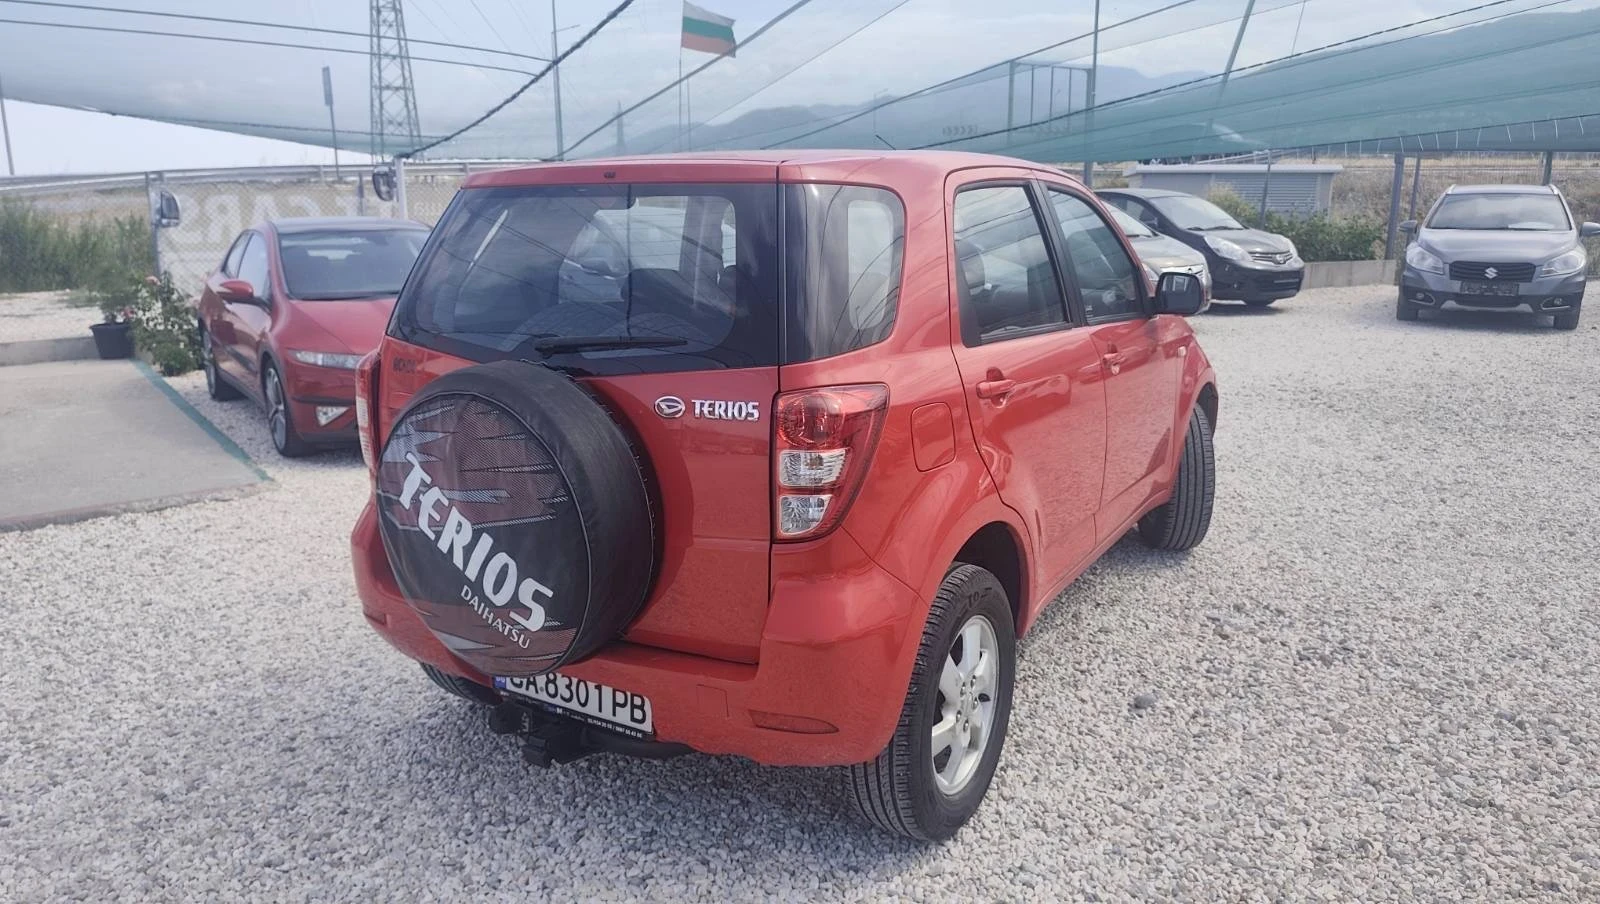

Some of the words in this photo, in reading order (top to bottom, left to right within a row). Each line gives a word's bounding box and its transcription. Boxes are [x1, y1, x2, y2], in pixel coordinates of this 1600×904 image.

[691, 400, 760, 421] TERIOS
[399, 452, 554, 632] TERIOS
[460, 584, 531, 649] DAIHATSU
[544, 671, 603, 713] 8301
[612, 688, 647, 725] PB
